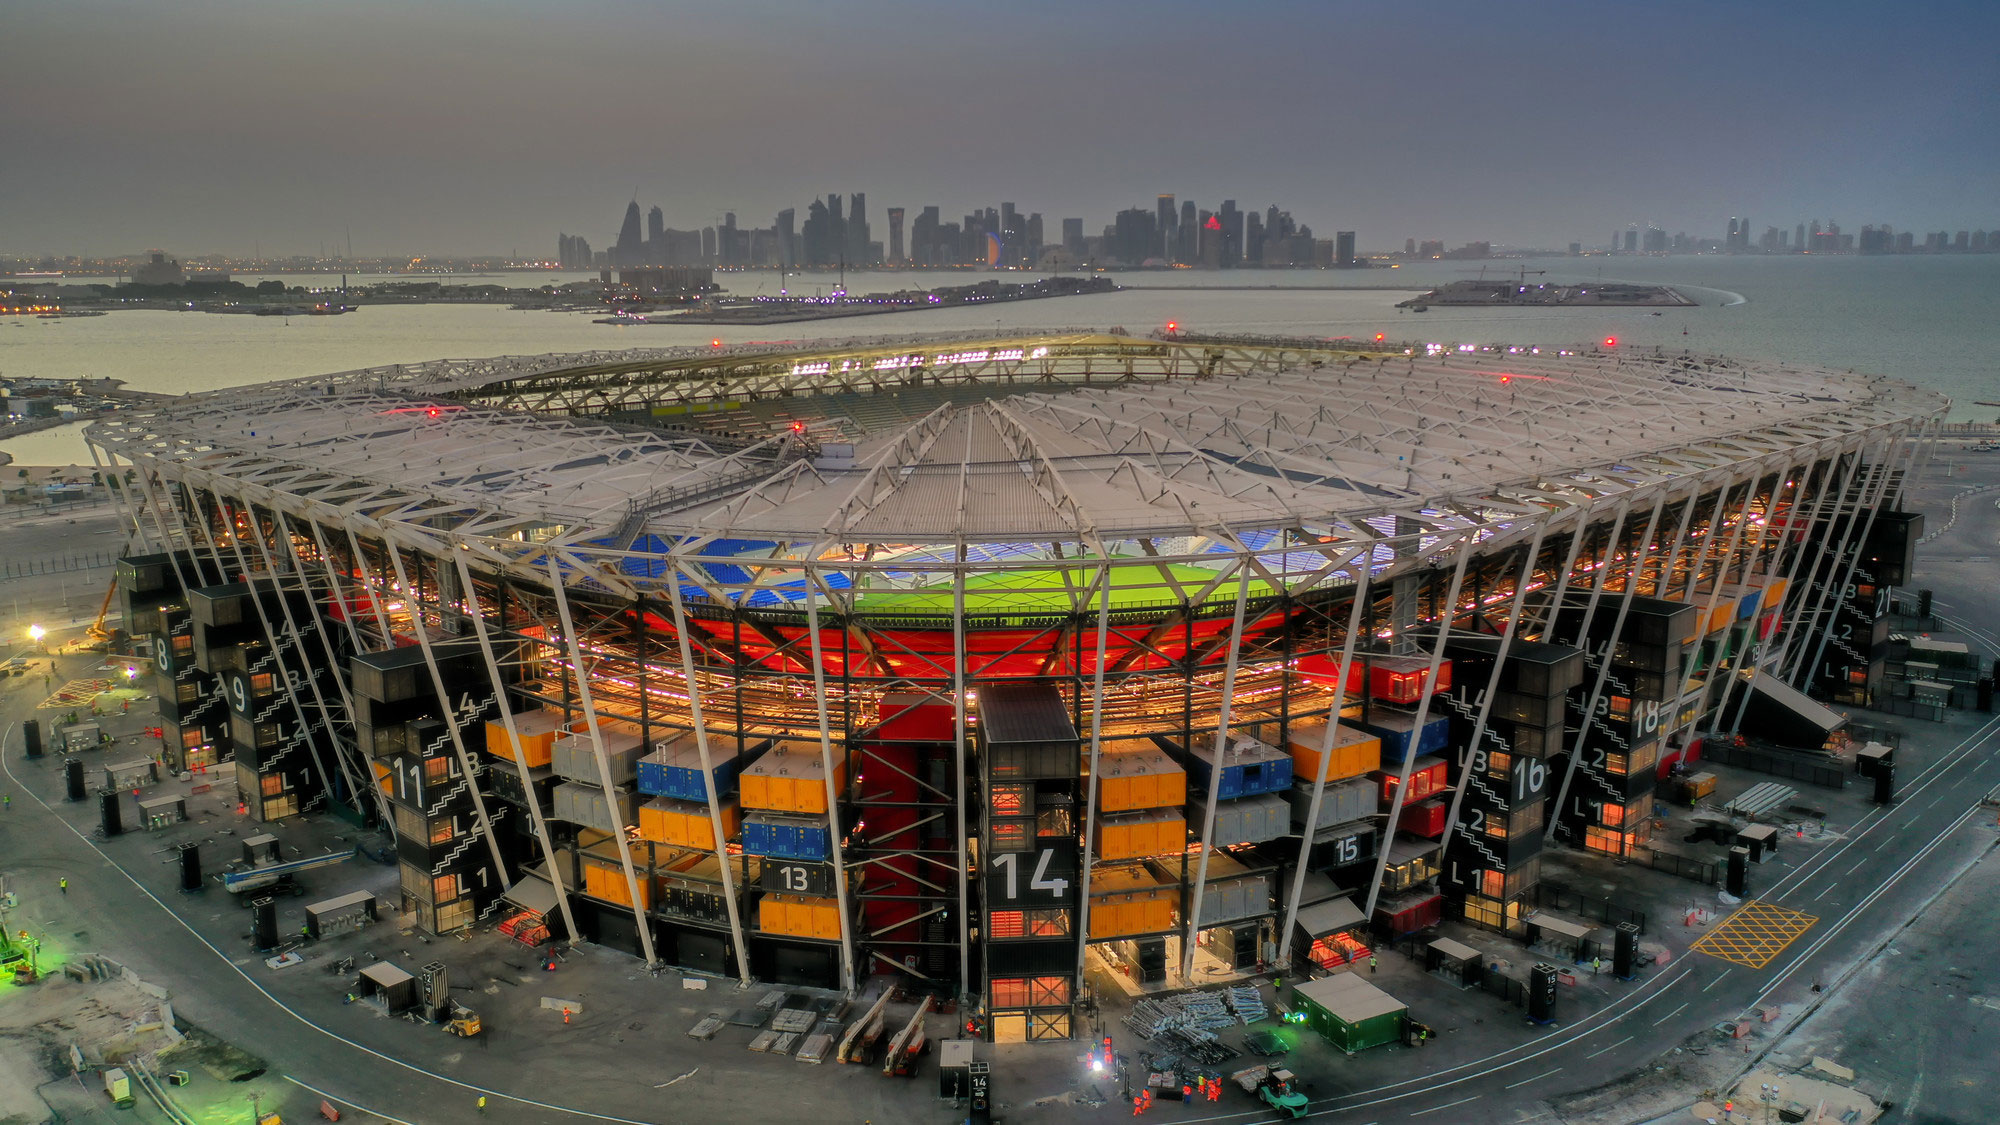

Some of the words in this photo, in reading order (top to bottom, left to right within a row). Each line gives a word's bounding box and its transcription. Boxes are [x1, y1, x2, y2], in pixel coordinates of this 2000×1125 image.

[1875, 585, 1892, 618] 21
[157, 638, 168, 671] 8
[233, 676, 245, 712] 9
[1634, 700, 1659, 738] 18
[394, 757, 422, 808] 11
[1515, 757, 1545, 800] 16
[1335, 837, 1358, 863] 15
[780, 866, 808, 891] 13
[992, 849, 1068, 899] 14
[1547, 975, 1556, 984] 15
[973, 1078, 987, 1087] 14
